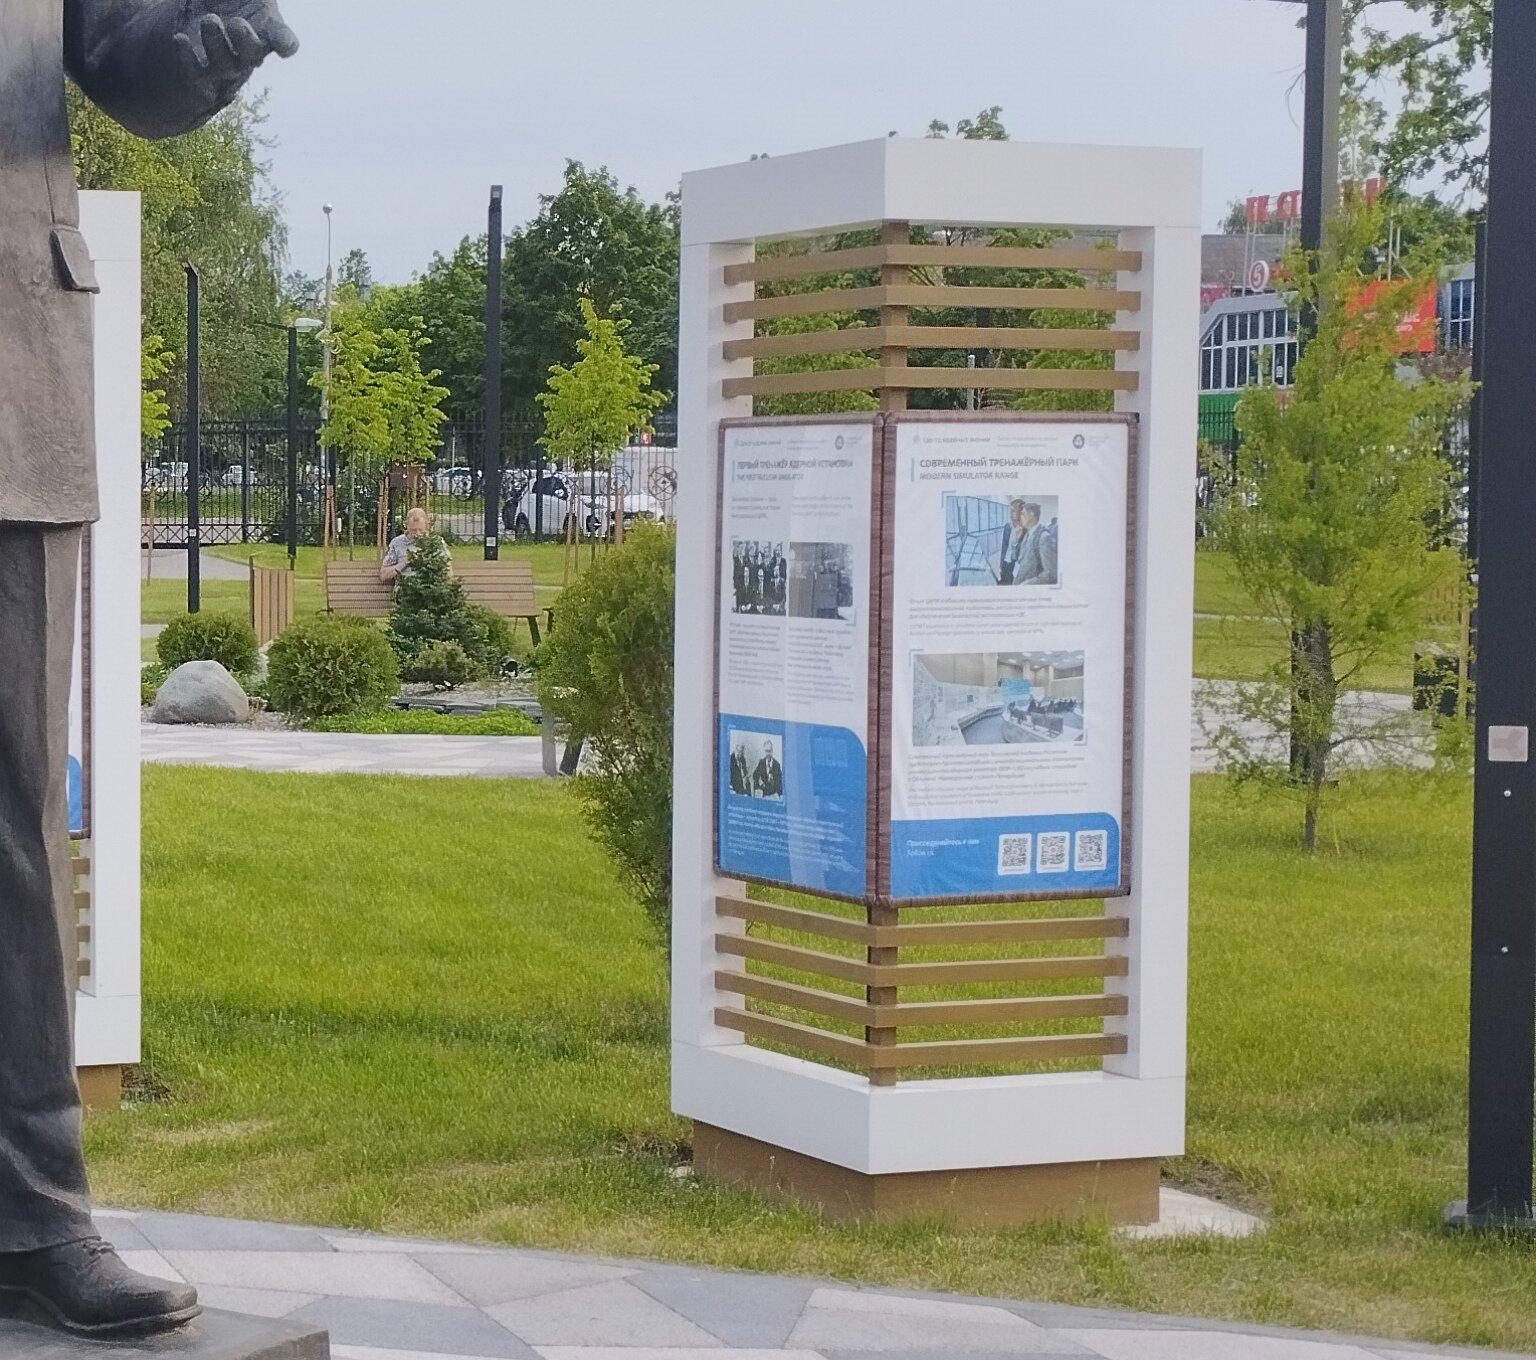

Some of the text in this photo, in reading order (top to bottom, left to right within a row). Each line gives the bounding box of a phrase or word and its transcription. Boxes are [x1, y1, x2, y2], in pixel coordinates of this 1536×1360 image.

[919, 456, 987, 468] СОВРЕМЕННЫЙ
[1056, 458, 1079, 467] ПАРК
[919, 471, 1019, 480] MODERN SIMULATOR RANGE
